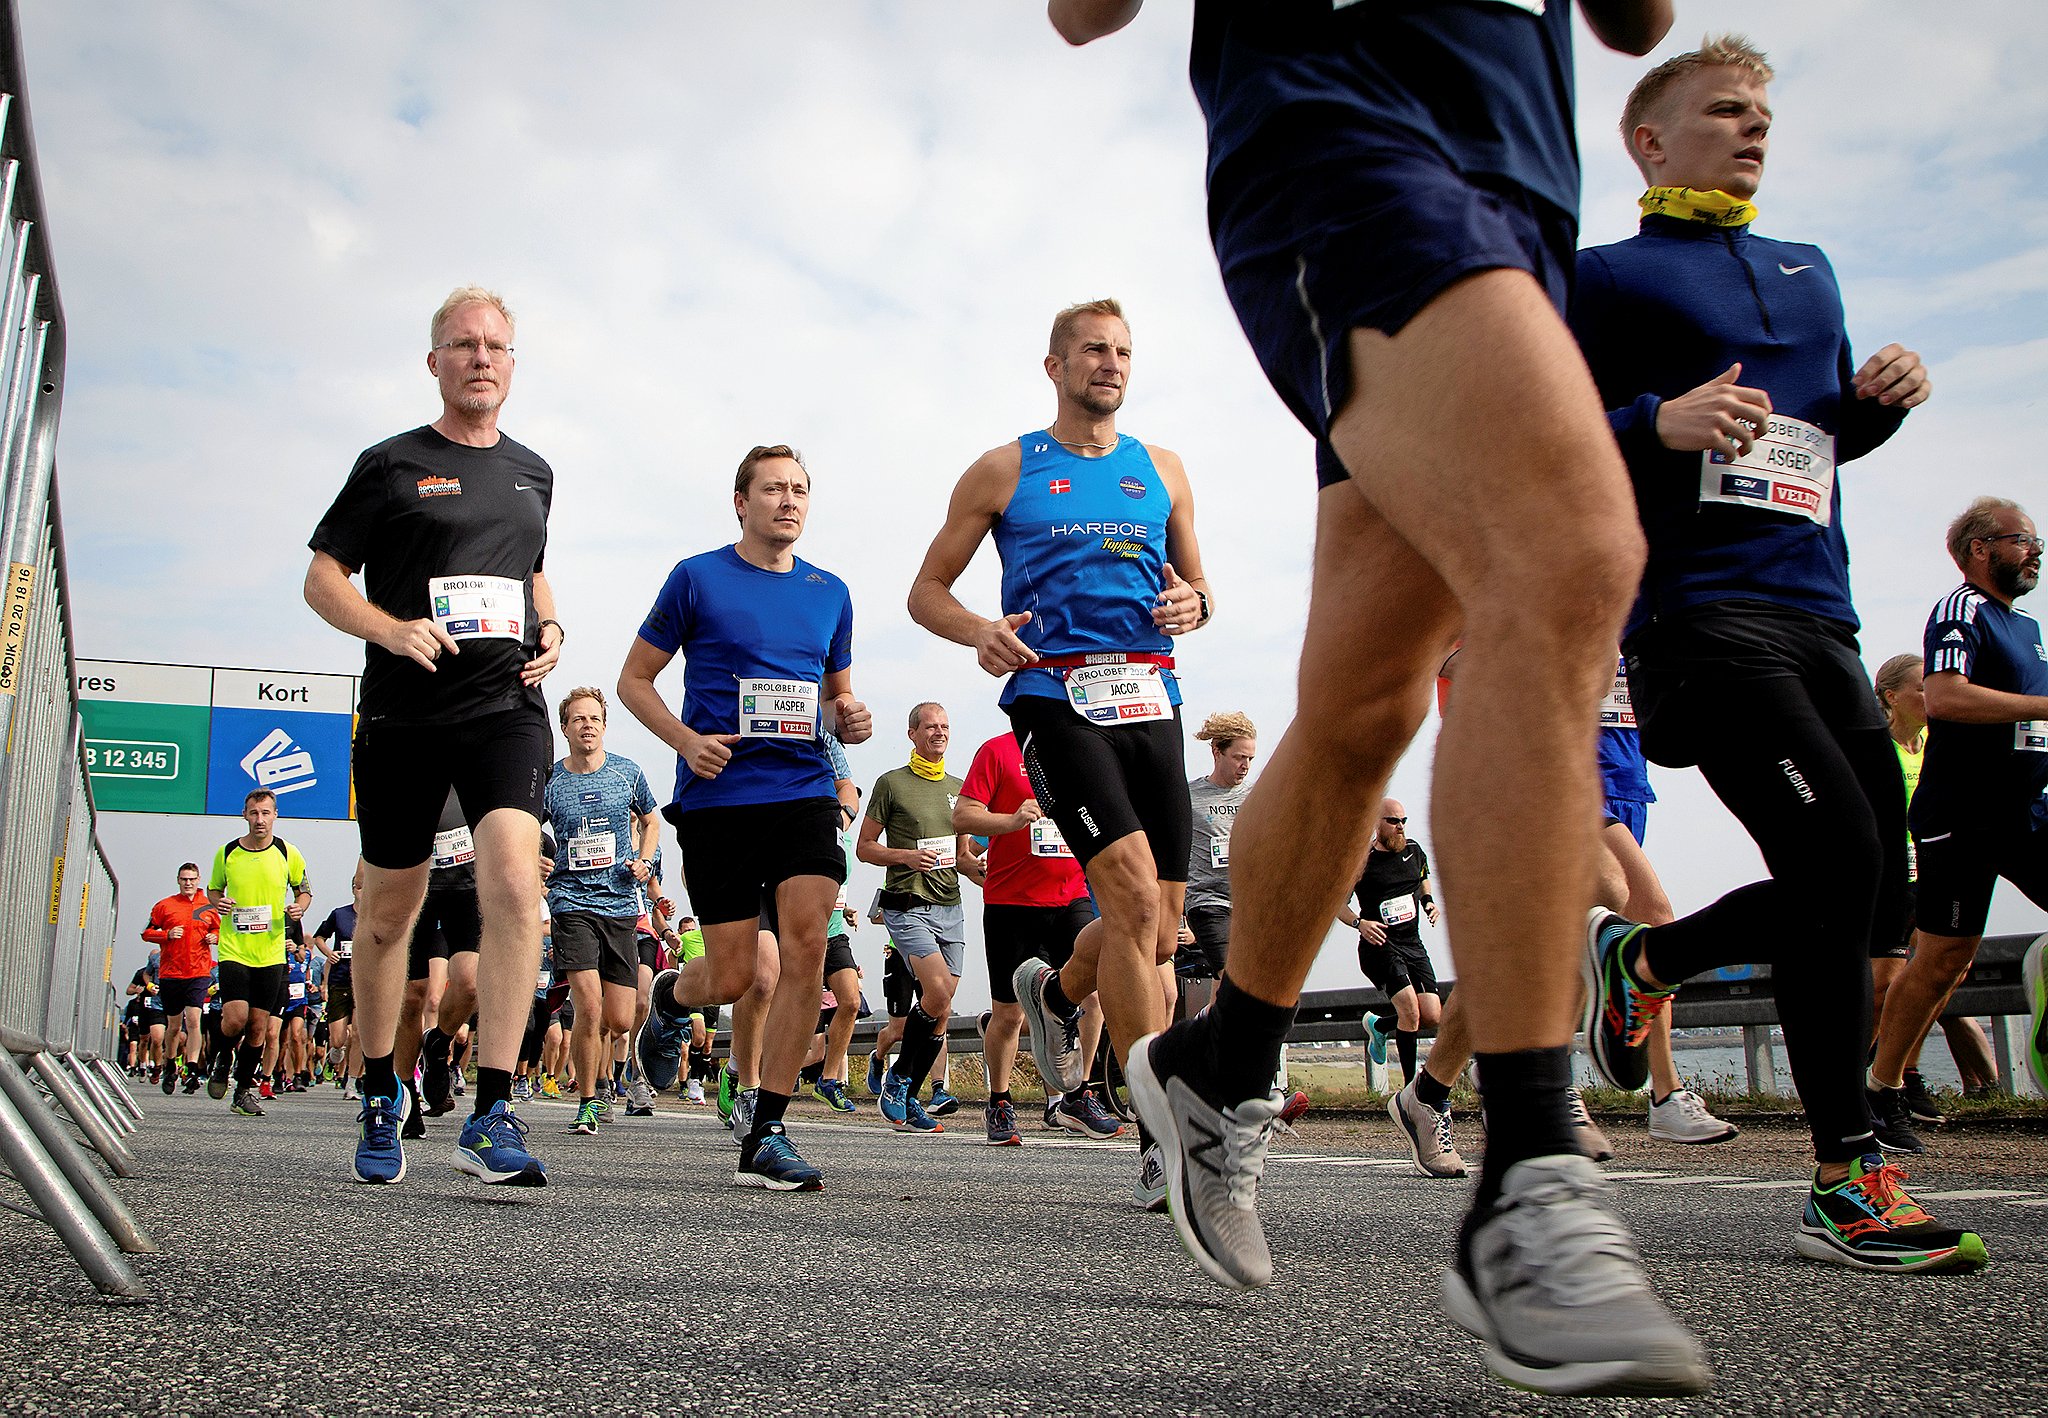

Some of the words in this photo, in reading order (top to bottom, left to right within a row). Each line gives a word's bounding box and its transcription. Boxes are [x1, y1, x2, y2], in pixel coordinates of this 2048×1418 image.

[1767, 448, 1811, 472] ASGER
[1051, 522, 1148, 539] HARBOE
[1101, 537, 1144, 553] Topform
[18, 568, 31, 583] 16
[15, 586, 27, 600] 18
[12, 604, 24, 620] 20
[8, 622, 21, 638] 70
[1077, 667, 1128, 682] BROLØBET
[78, 676, 116, 692] res
[752, 683, 797, 693] BROLØBET
[798, 685, 812, 694] 2021
[1111, 683, 1140, 696] JACOB
[258, 682, 309, 702] Kort
[774, 699, 806, 712] KASPER
[1122, 705, 1158, 716] VELUX
[784, 723, 811, 733] VELUX
[103, 749, 126, 768] 12
[130, 751, 167, 769] 345
[1778, 759, 1817, 804] FUSION
[1077, 806, 1101, 838] FUSION
[452, 840, 467, 850] JEPPE
[587, 846, 606, 855] STEFAN
